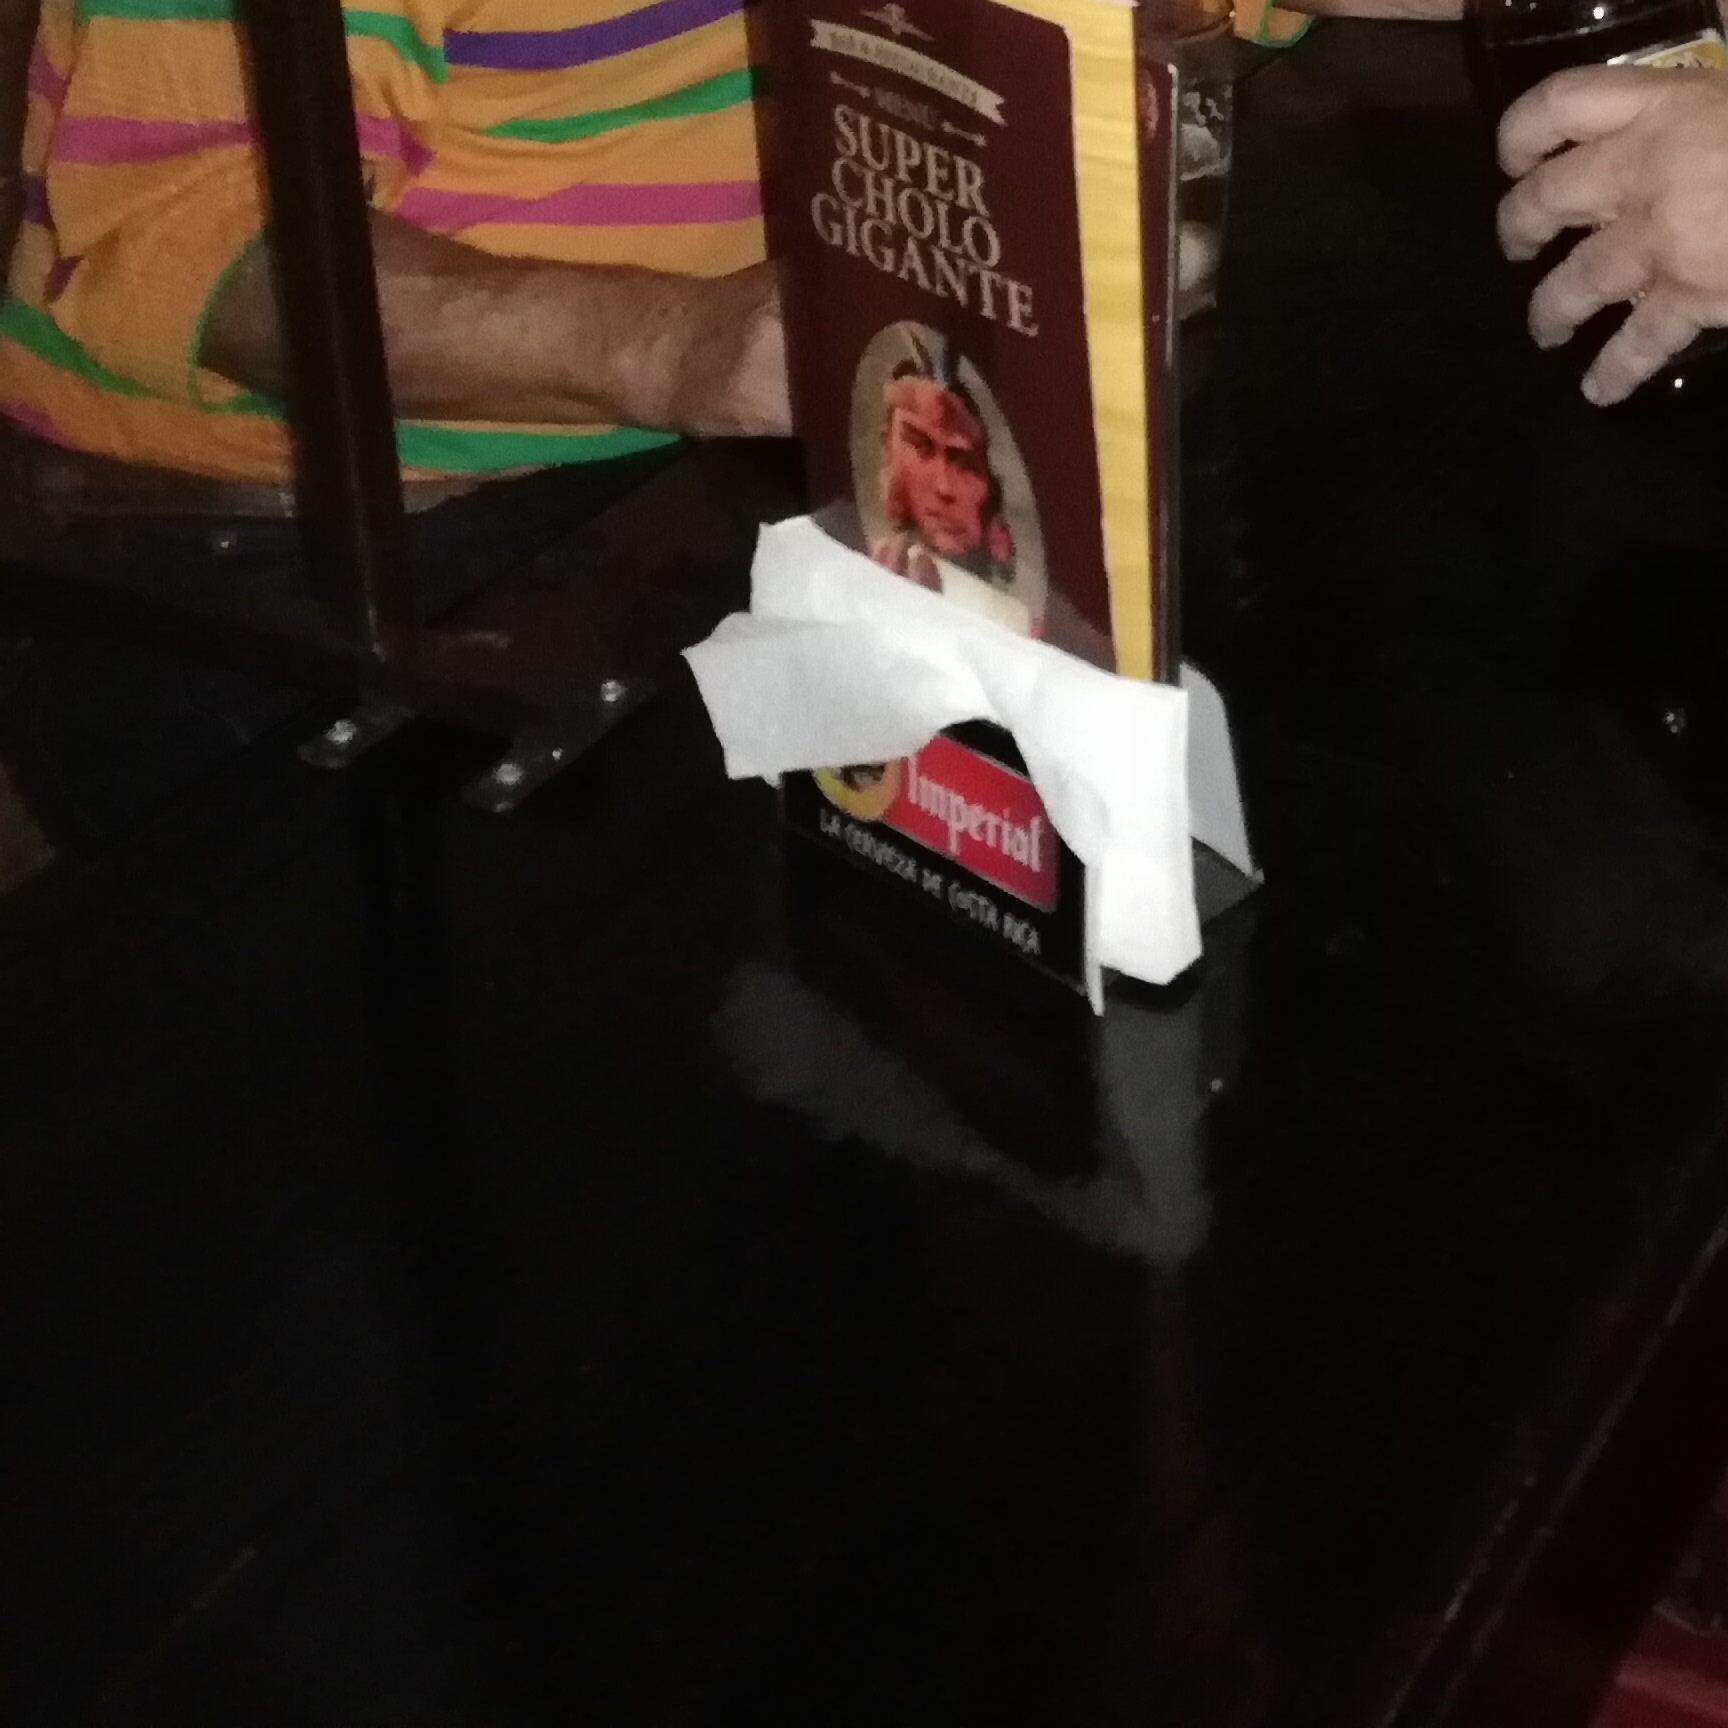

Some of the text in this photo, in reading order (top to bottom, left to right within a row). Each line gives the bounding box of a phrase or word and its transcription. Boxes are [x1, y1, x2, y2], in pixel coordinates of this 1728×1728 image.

[831, 158, 1001, 271] CHOLO
[833, 103, 988, 217] SUPER
[810, 192, 1039, 338] GIGANTE
[906, 746, 1042, 872] Imperial
